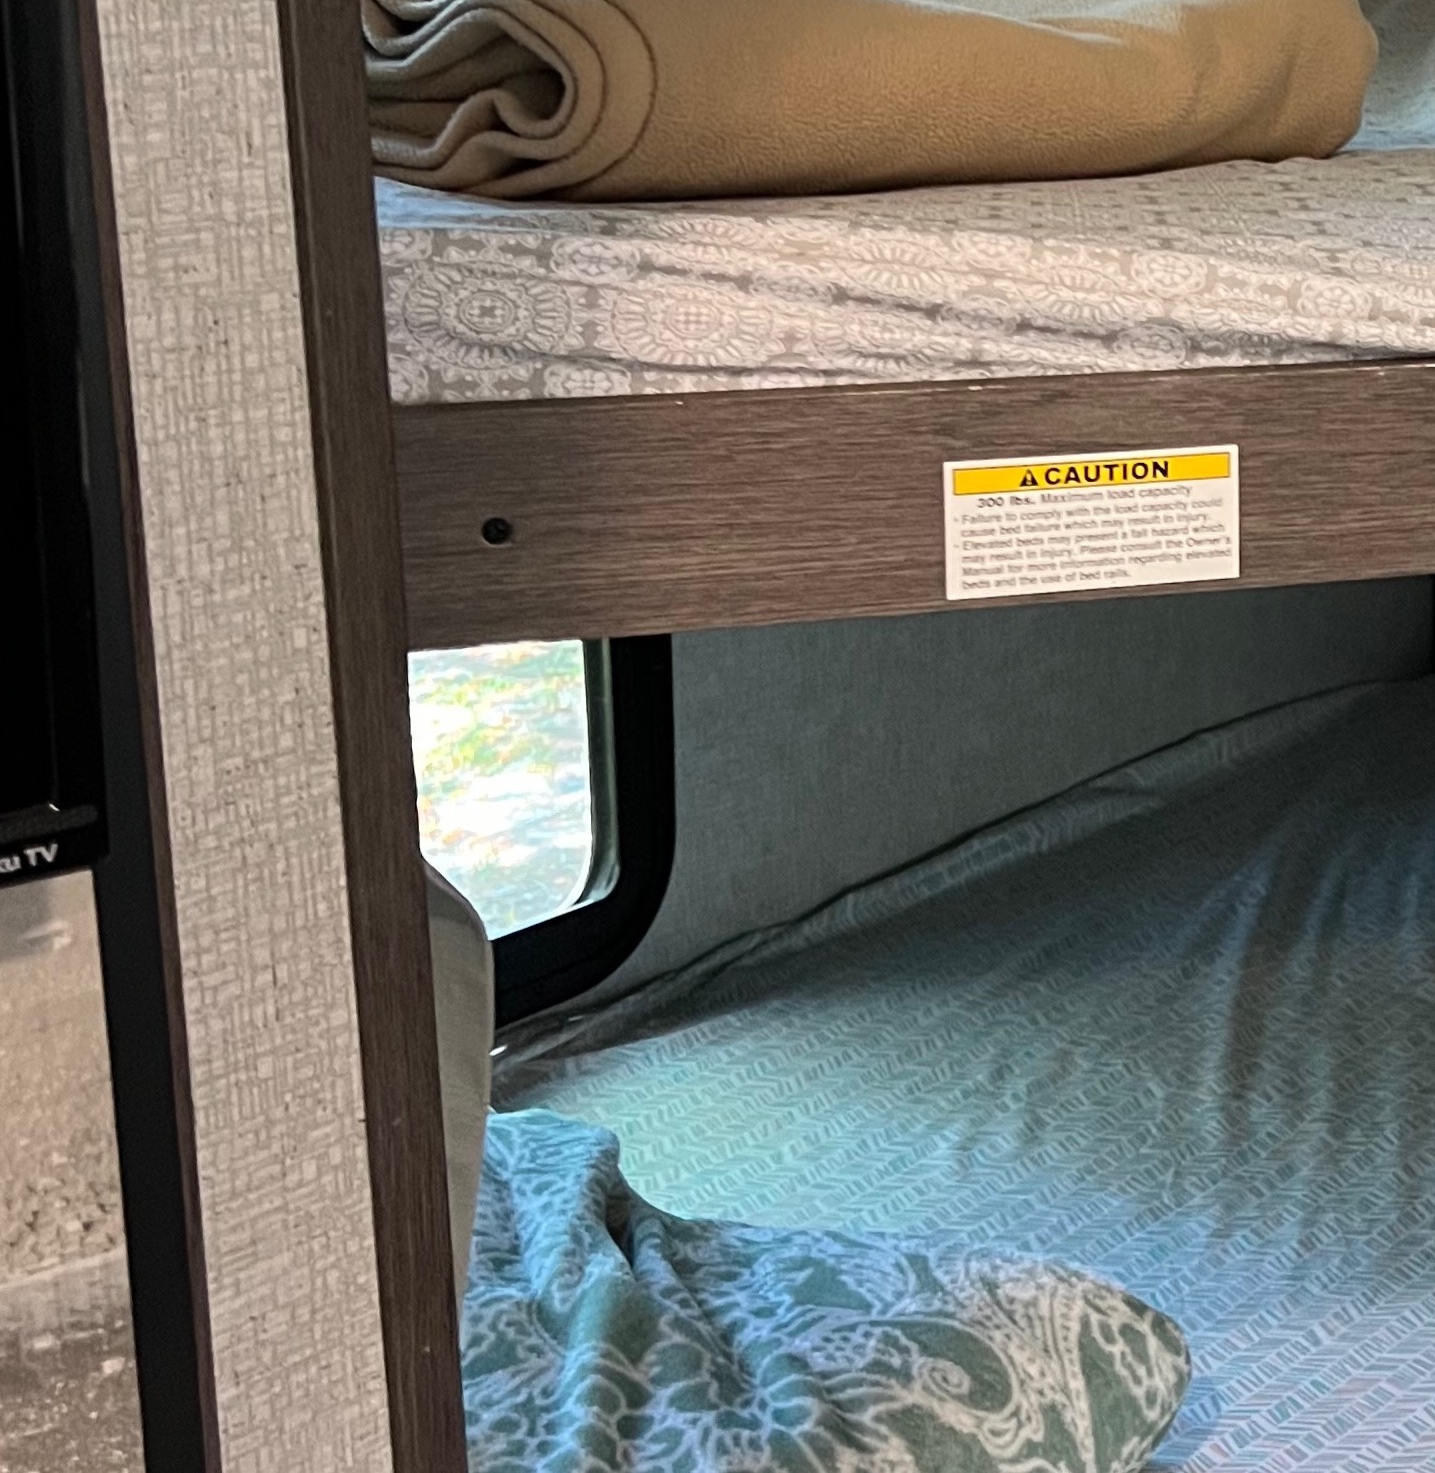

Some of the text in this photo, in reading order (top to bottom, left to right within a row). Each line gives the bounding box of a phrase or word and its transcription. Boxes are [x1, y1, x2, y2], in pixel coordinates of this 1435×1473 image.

[1044, 459, 1169, 486] CAUTION
[976, 496, 1003, 508] 300
[23, 843, 58, 866] TV
